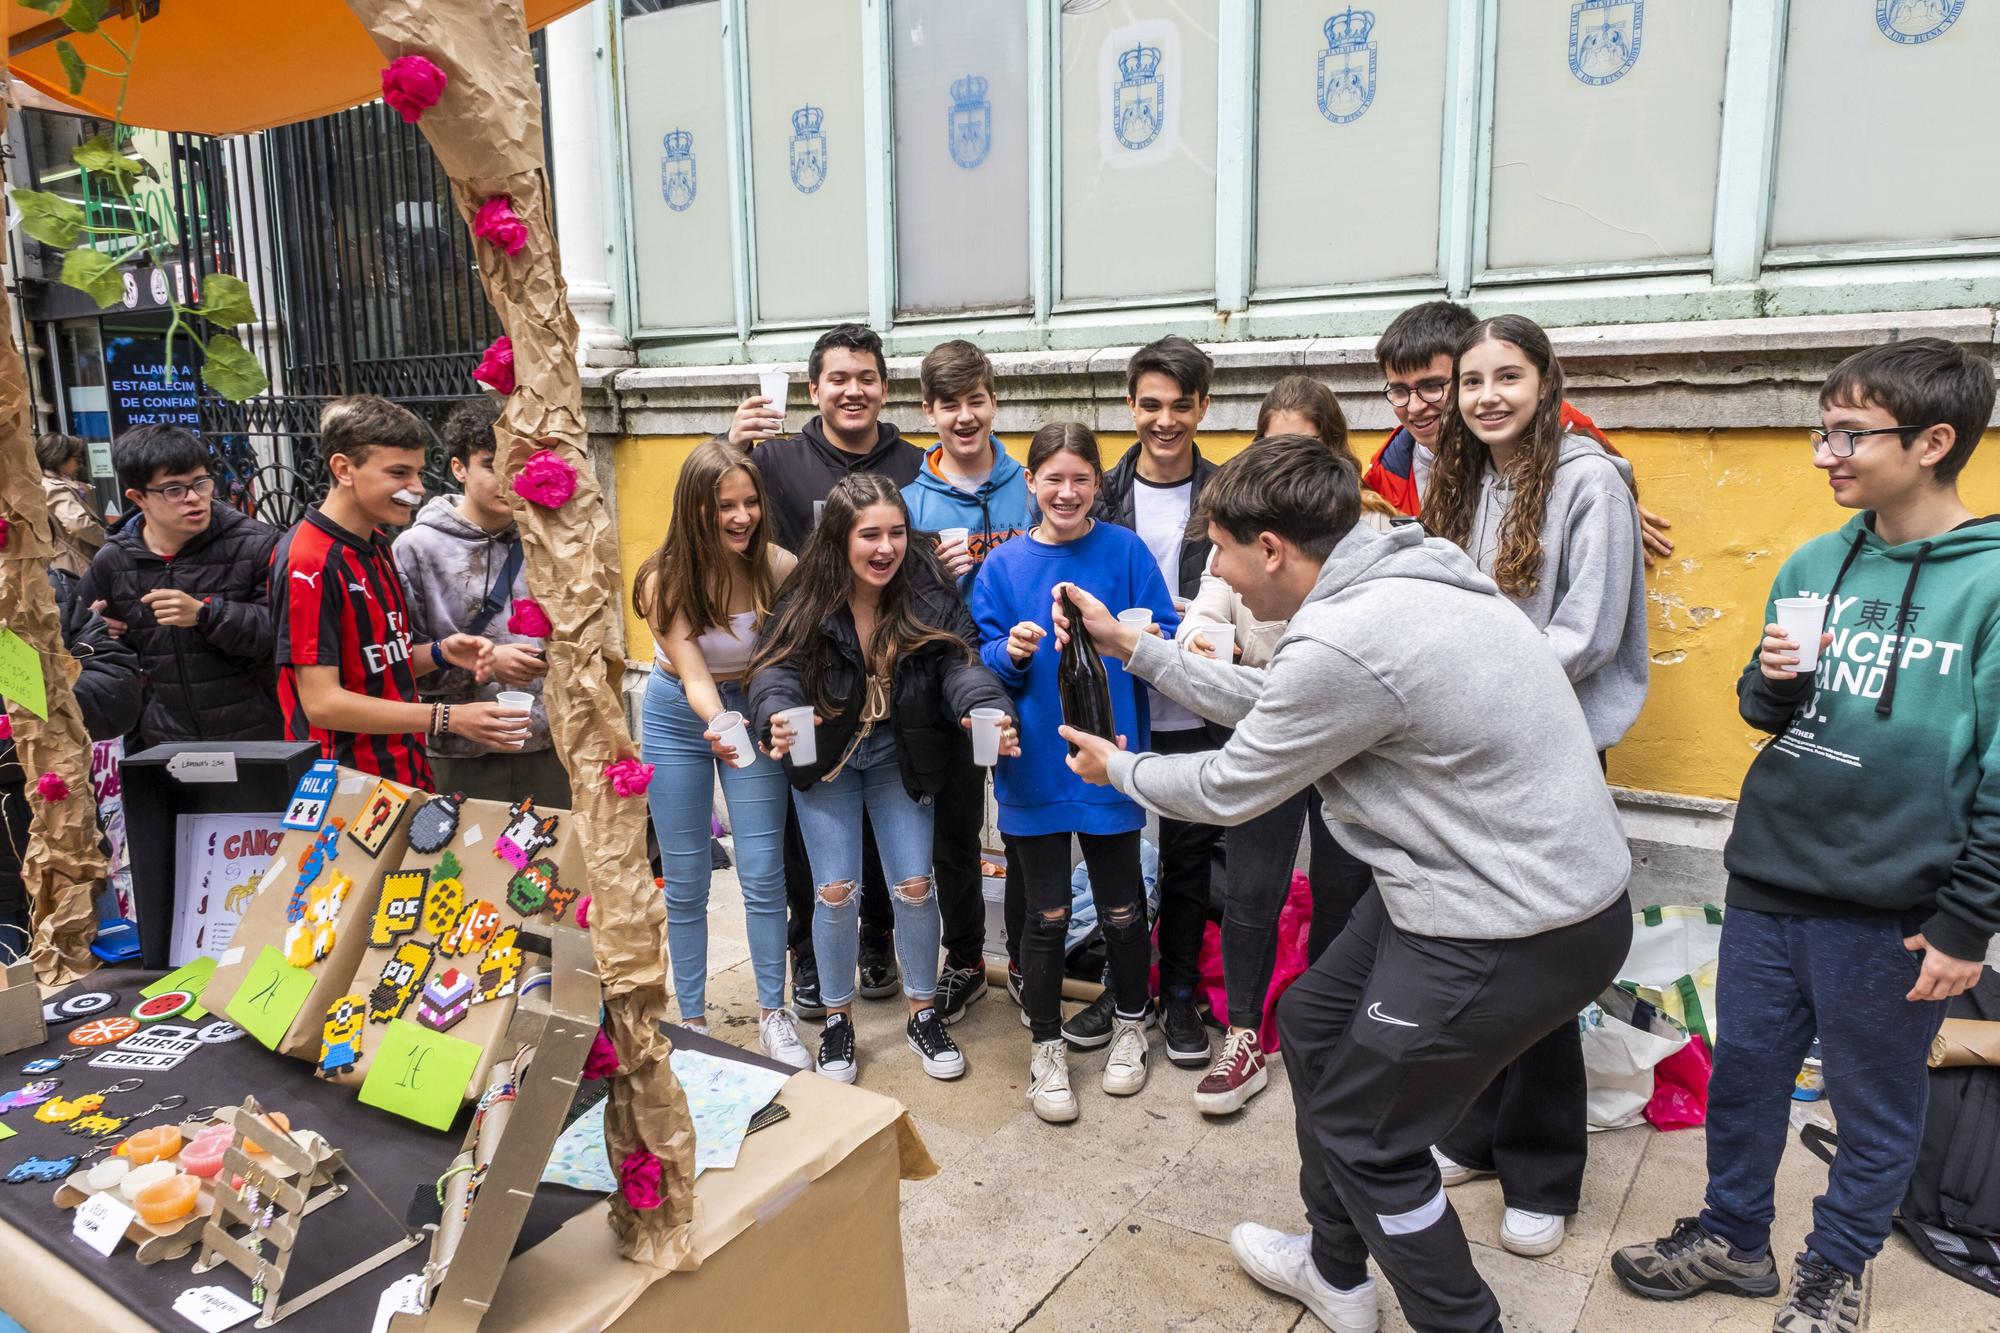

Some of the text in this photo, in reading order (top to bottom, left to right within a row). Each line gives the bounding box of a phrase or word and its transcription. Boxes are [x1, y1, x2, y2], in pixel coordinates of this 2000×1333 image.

[121, 398, 140, 408] DE
[129, 414, 156, 424] HAZ
[159, 414, 176, 423] TU
[1825, 626, 1963, 676] NCEPT
[98, 1053, 176, 1066] CARLA
